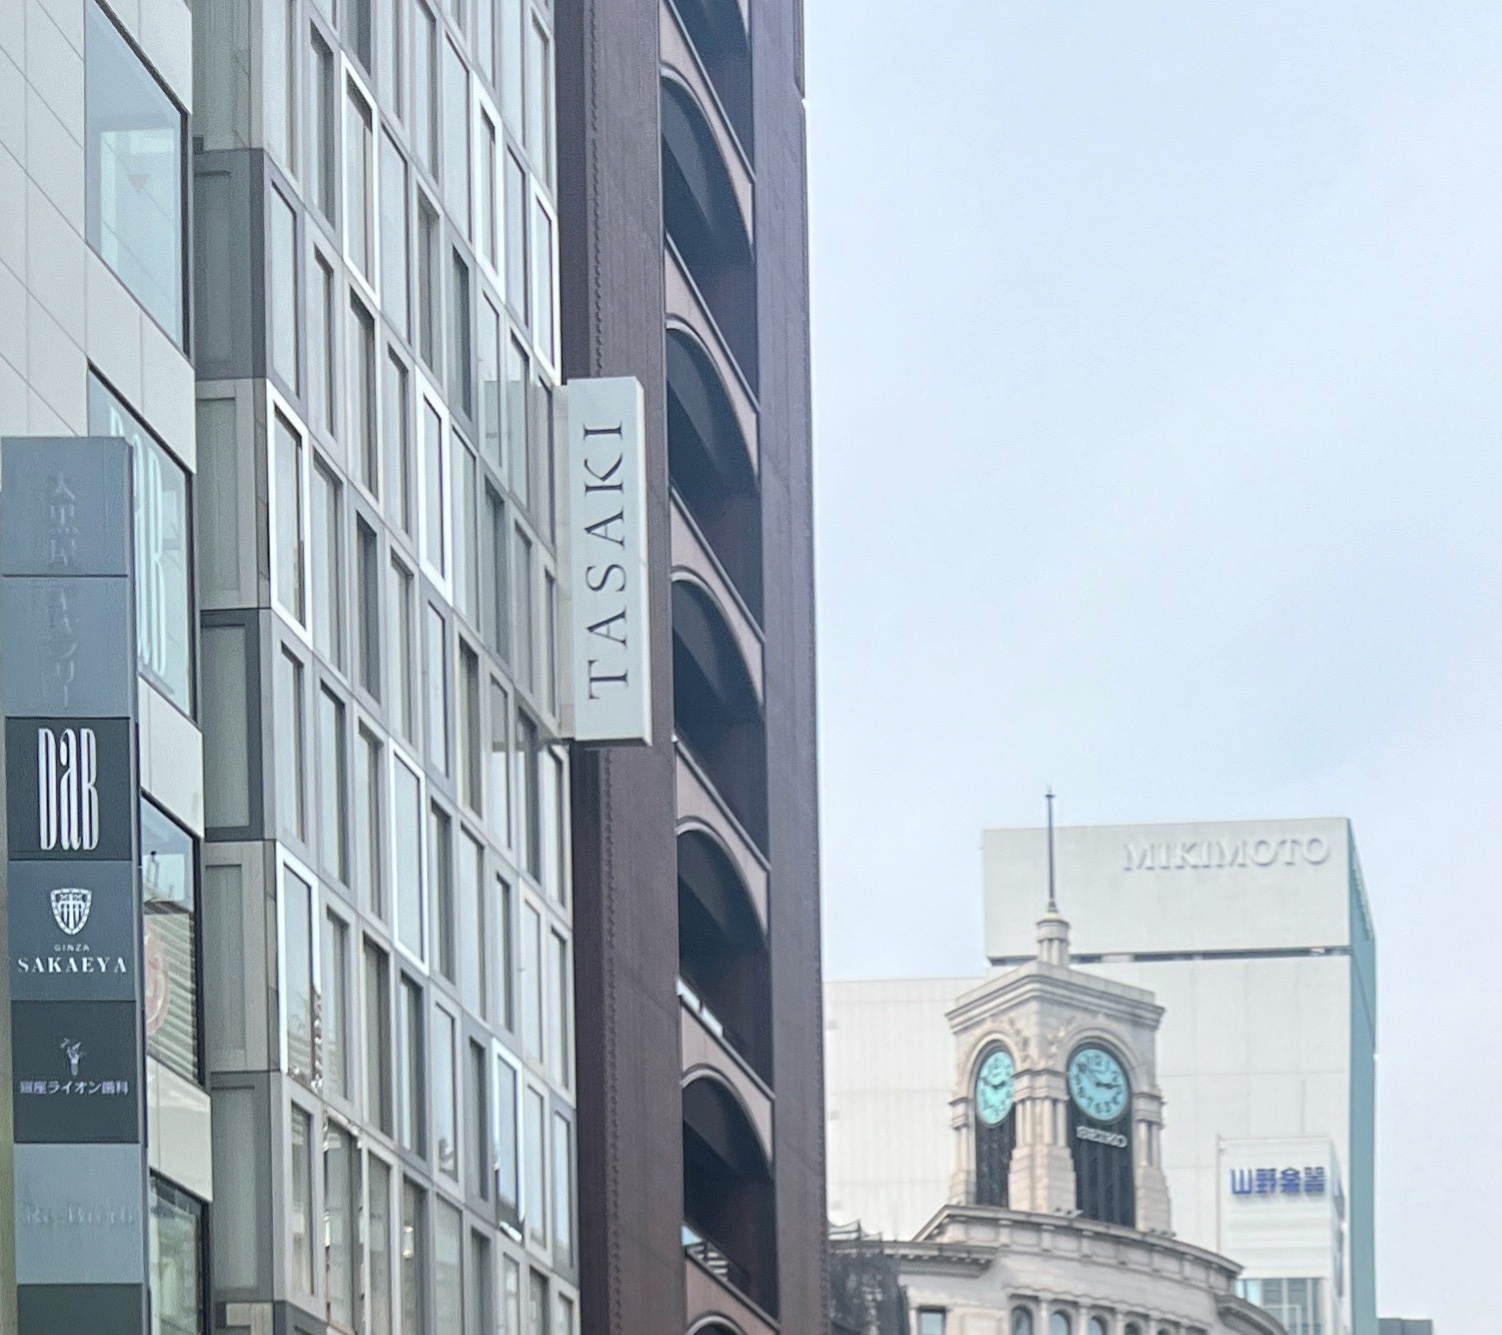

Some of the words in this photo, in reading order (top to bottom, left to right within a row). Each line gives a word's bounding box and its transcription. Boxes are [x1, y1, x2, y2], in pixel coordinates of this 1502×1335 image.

[583, 421, 629, 700] TASAKI
[1122, 837, 1331, 872] MIKIMOTO
[54, 944, 90, 952] GINZA
[17, 956, 127, 973] SAKAEYA
[1076, 1126, 1127, 1148] SEIKO
[1231, 1166, 1325, 1195] 山野楽器
